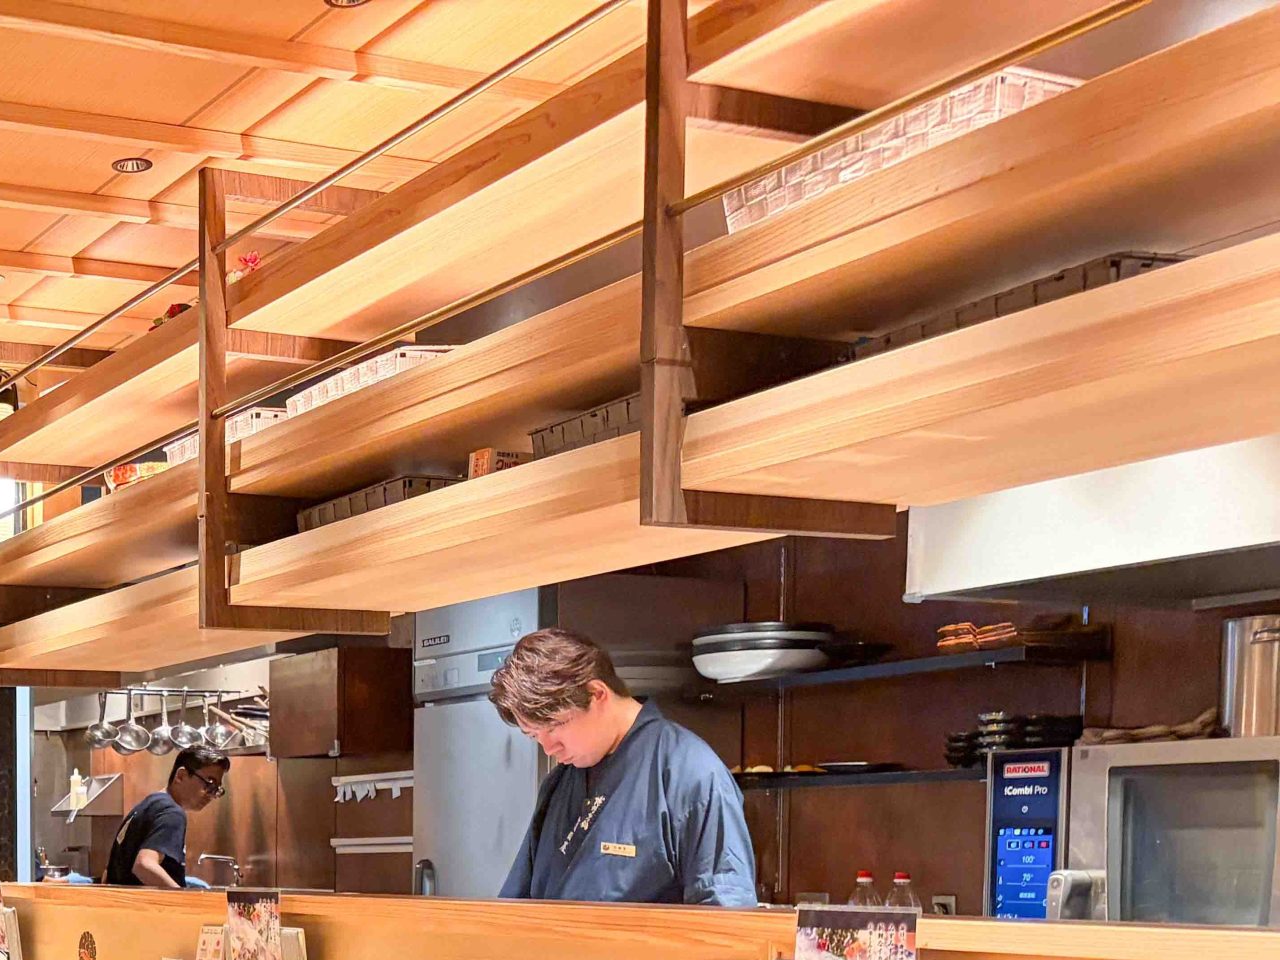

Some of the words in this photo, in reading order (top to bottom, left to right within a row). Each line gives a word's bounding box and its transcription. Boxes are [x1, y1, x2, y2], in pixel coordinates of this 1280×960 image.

[1006, 766, 1046, 775] RATIONAL
[1004, 786, 1033, 796] iCombi
[1034, 785, 1048, 795] Pro
